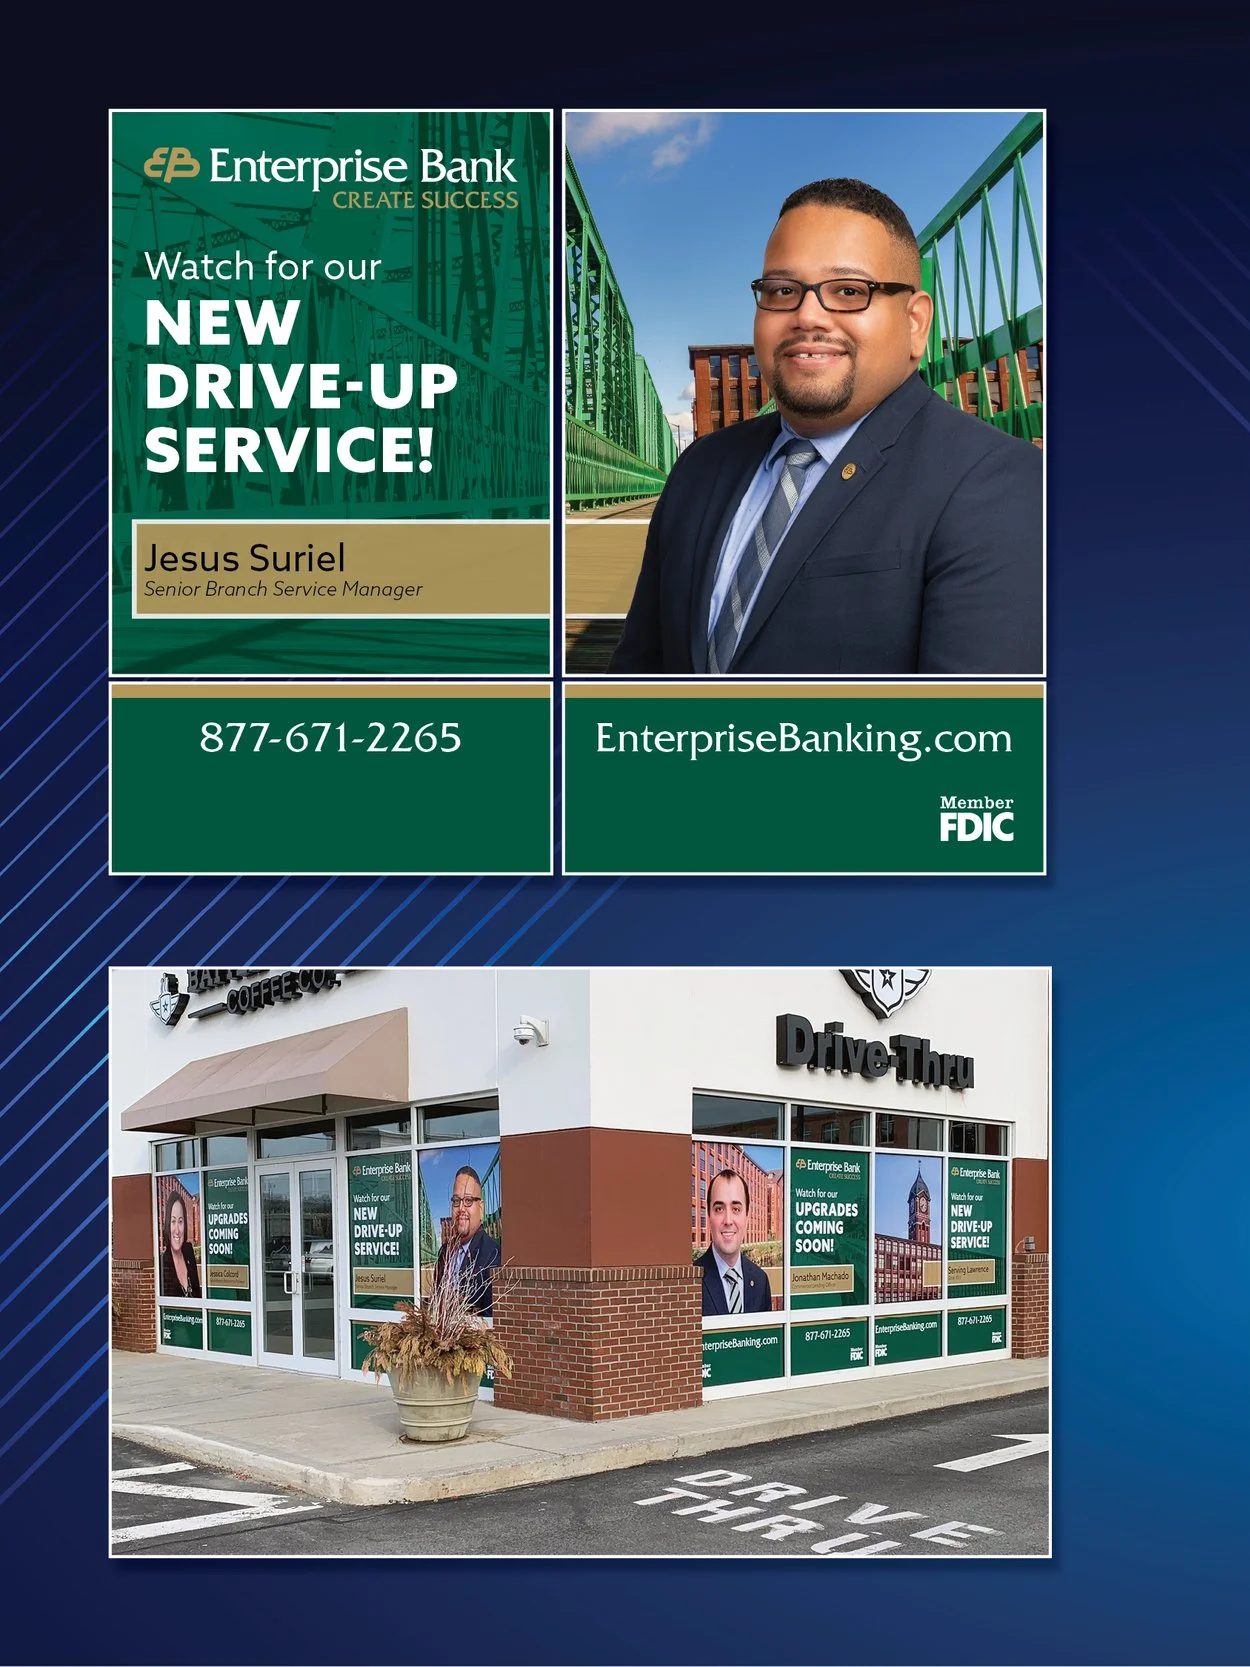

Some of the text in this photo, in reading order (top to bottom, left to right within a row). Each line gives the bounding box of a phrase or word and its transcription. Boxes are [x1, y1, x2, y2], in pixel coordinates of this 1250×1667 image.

[210, 147, 518, 190] Enterprise Bank
[332, 190, 519, 209] CREATE SUCCESS
[143, 249, 382, 281] Watch for our
[146, 299, 301, 346] NEW
[146, 363, 458, 410] DRIVE-UP
[145, 426, 434, 474] SERVICE!
[144, 541, 344, 572] Jesus Suriel
[143, 579, 424, 601] Senior Branch Service Manager
[200, 721, 461, 753] 877-671-2265
[596, 722, 1012, 762] EnterpriseBanking.com
[939, 795, 1014, 810] Member
[940, 811, 1014, 842] FDIC
[227, 971, 302, 1015] COFFEE
[776, 1013, 974, 1089] Drive-Thru
[808, 1159, 860, 1173] Enterprise Bank
[354, 1207, 378, 1220] NEW
[796, 1202, 858, 1217] UPGRADES
[951, 1204, 972, 1217] NEW
[354, 1224, 402, 1238] DRIVE-UP
[795, 1221, 843, 1234] COMING
[951, 1220, 992, 1233] DRIVE-UP
[354, 1242, 399, 1256] SERVICE!
[795, 1239, 834, 1253] SOON!
[951, 1236, 989, 1249] SERVICE!
[792, 1271, 849, 1283] Jonathan Machado
[948, 1266, 966, 1276] Serving
[805, 1328, 851, 1341] 877-671-2265
[876, 1322, 937, 1334] EnterpriseBanking.com
[674, 1469, 1004, 1548] DRIVE
